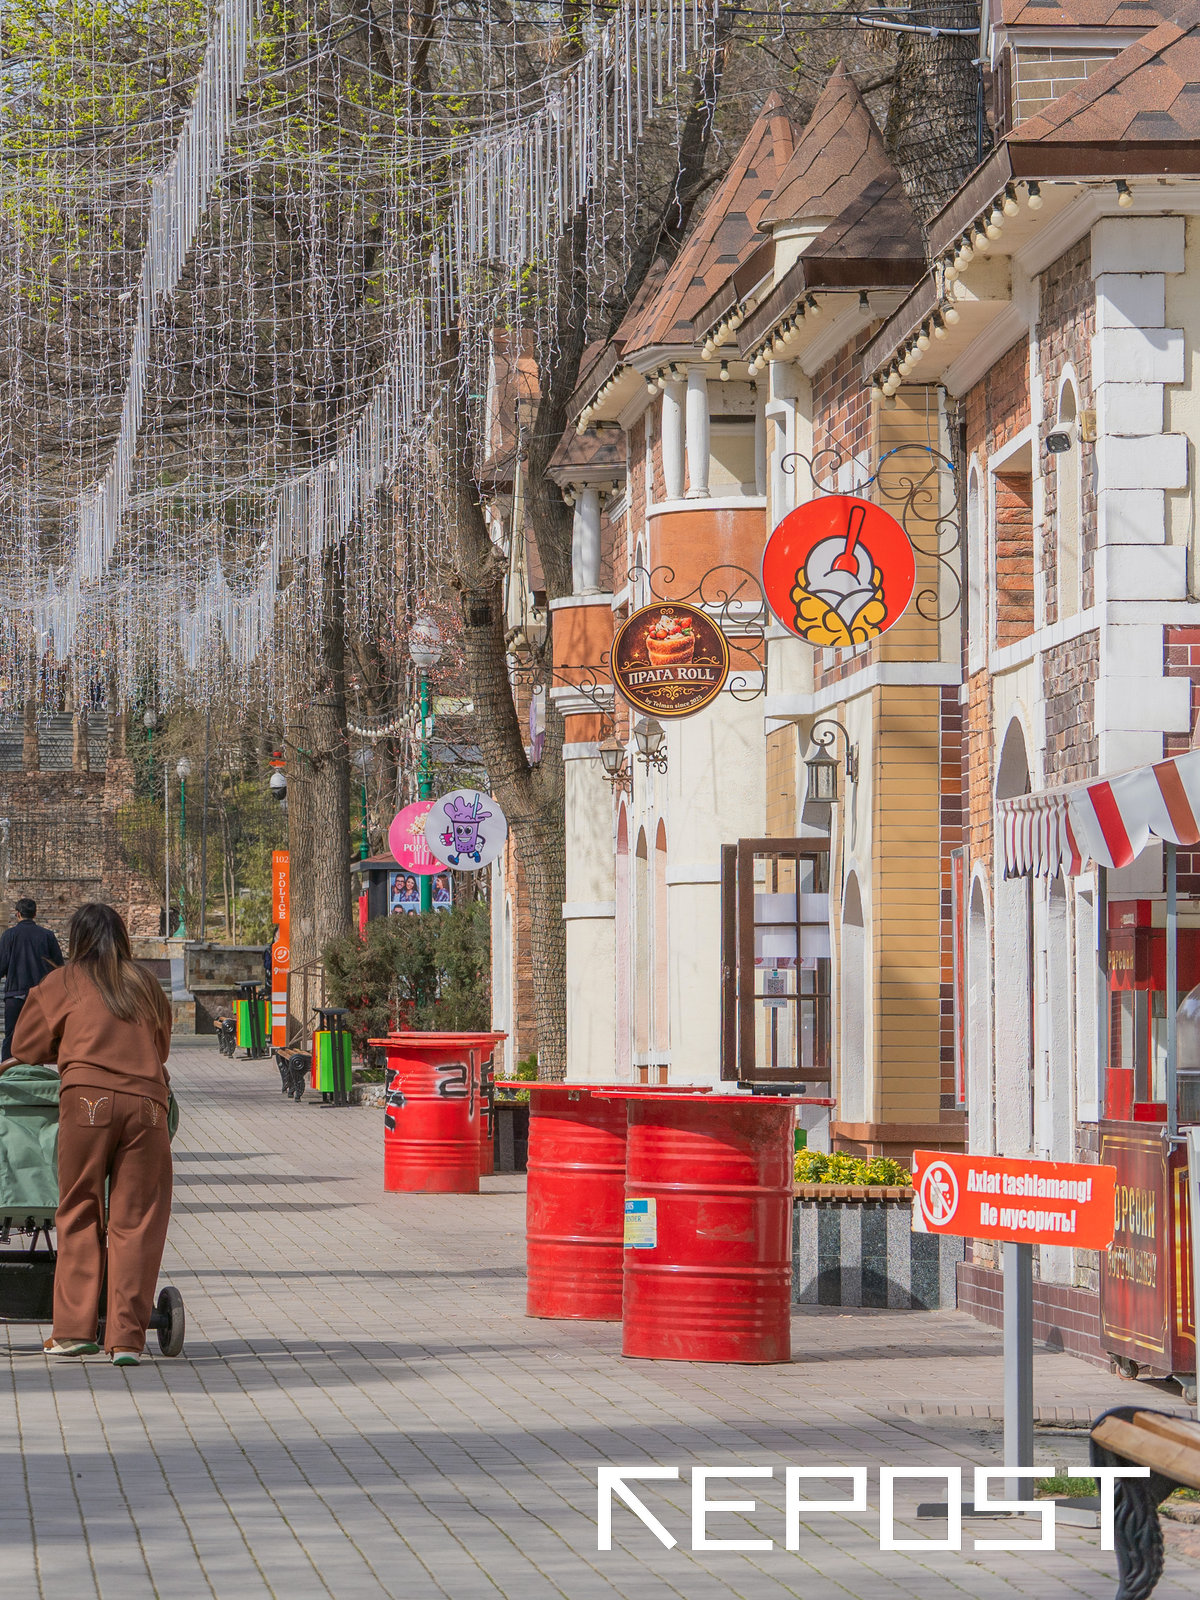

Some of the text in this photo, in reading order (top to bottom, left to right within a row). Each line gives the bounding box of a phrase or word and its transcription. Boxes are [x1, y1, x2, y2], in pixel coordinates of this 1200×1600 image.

[628, 667, 715, 685] ПРАГА ROLL
[275, 855, 289, 864] 102
[403, 843, 422, 853] POP
[278, 872, 286, 919] POLICE
[967, 1169, 1092, 1204] Axlat tashlamang!
[980, 1203, 1076, 1233] Не мусорить!
[1114, 1184, 1156, 1239] OPCORN
